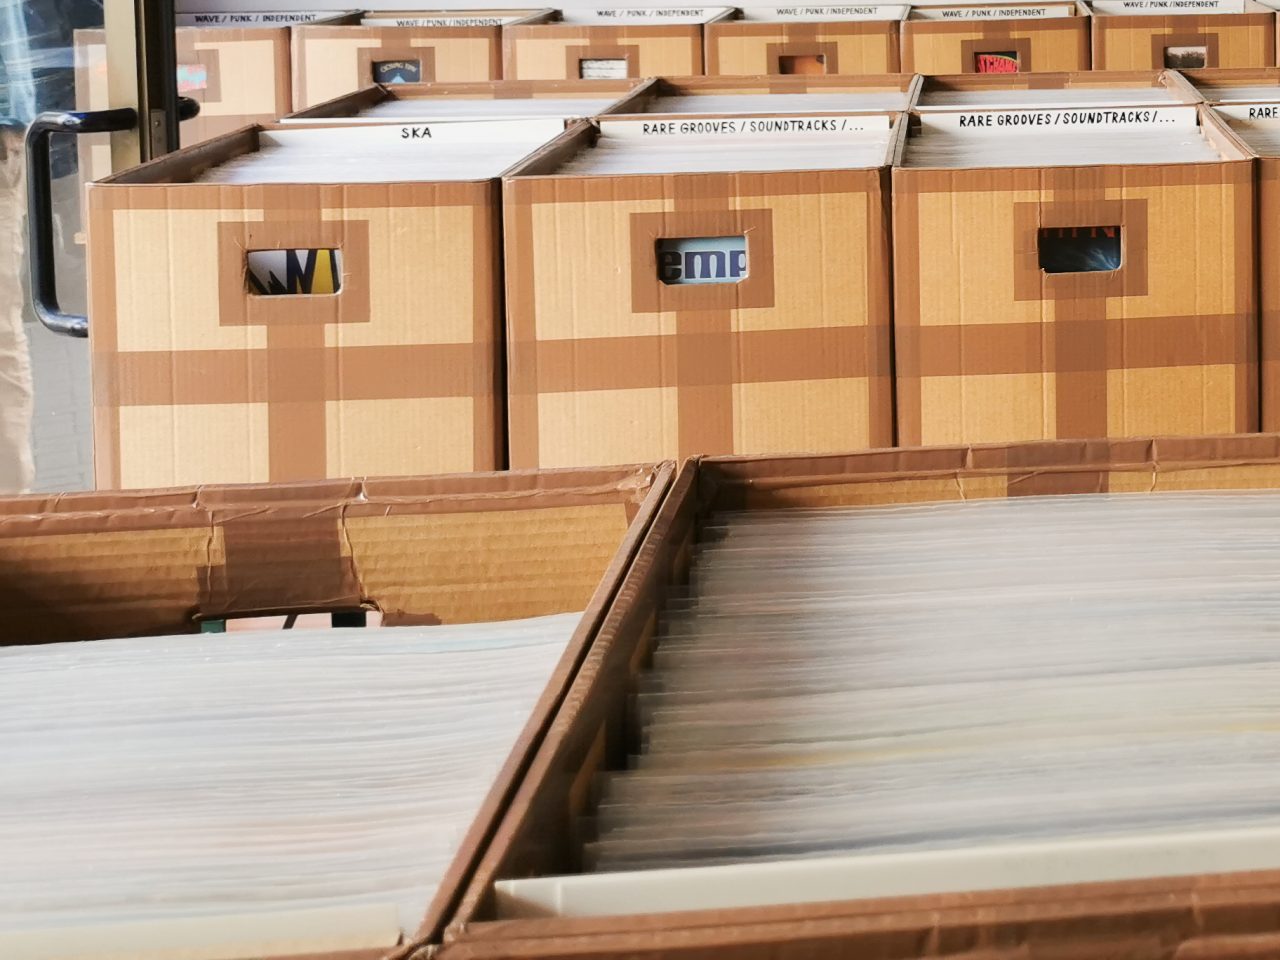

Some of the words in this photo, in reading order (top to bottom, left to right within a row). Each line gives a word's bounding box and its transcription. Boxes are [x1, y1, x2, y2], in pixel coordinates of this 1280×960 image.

[1123, 1, 1144, 9] WAVE
[1173, 0, 1219, 8] INDEPENDENT
[597, 10, 617, 18] WAVE
[656, 9, 704, 17] INDEPENDENT
[776, 8, 798, 16] WAVE
[830, 7, 878, 15] INDEPENDENT
[942, 10, 963, 18] WAVE
[972, 9, 992, 17] PUNK
[999, 8, 1046, 16] INDEPENDENT
[194, 14, 220, 23] WAVE
[230, 14, 252, 22] PUNK
[263, 14, 317, 22] INDEPENDENT
[427, 19, 448, 27] PUNK
[453, 18, 503, 27] INDEPENDENT
[1249, 107, 1279, 120] RARE
[959, 114, 993, 127] RARE
[997, 113, 1052, 126] GROOVES
[1062, 111, 1150, 125] SOUNDTRACKS
[643, 122, 676, 135] RARE
[680, 121, 737, 134] GROOVES
[750, 119, 837, 132] SOUNDTRACKS
[401, 127, 432, 139] SKA
